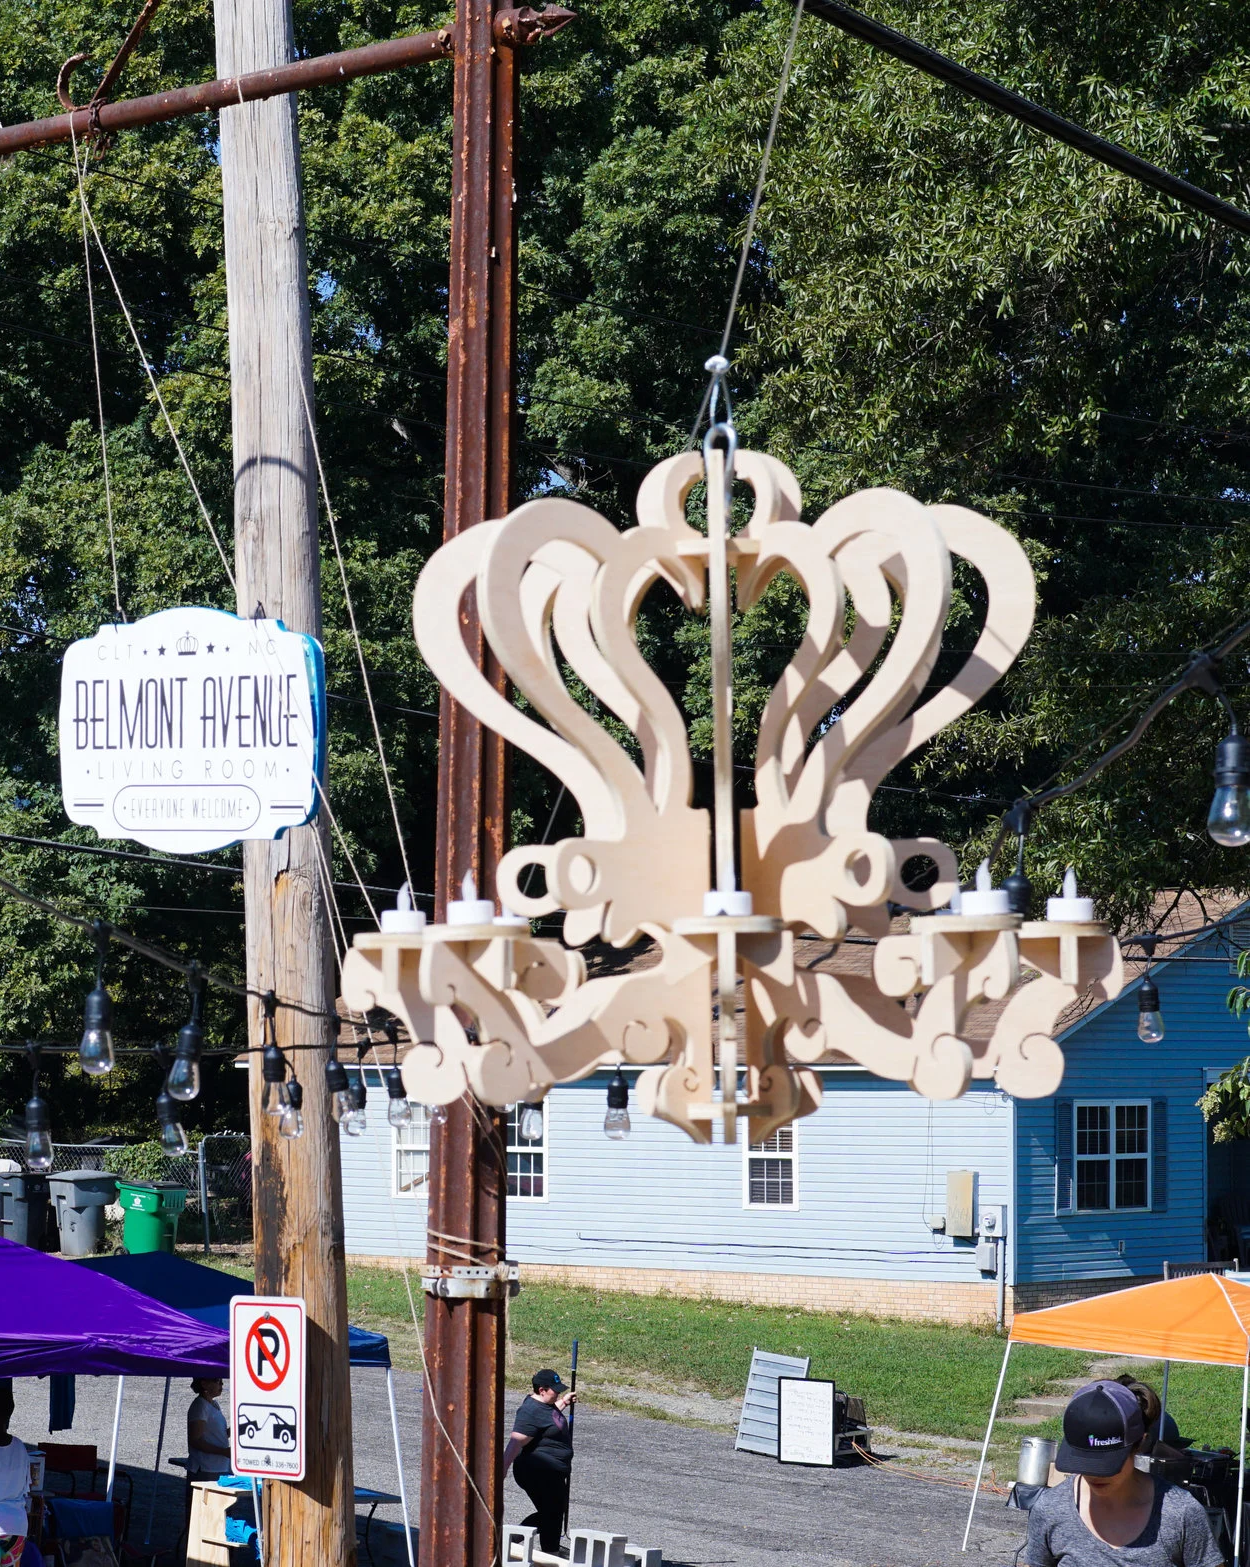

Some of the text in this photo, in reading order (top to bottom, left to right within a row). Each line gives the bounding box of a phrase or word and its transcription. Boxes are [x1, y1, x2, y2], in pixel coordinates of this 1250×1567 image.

[97, 639, 277, 661] CLT NC
[73, 674, 298, 750] BELMONT AVENUE
[97, 759, 278, 780] LIVING ROOM
[130, 797, 243, 819] EVERYONE WELCOME
[242, 1458, 260, 1467] TOWED
